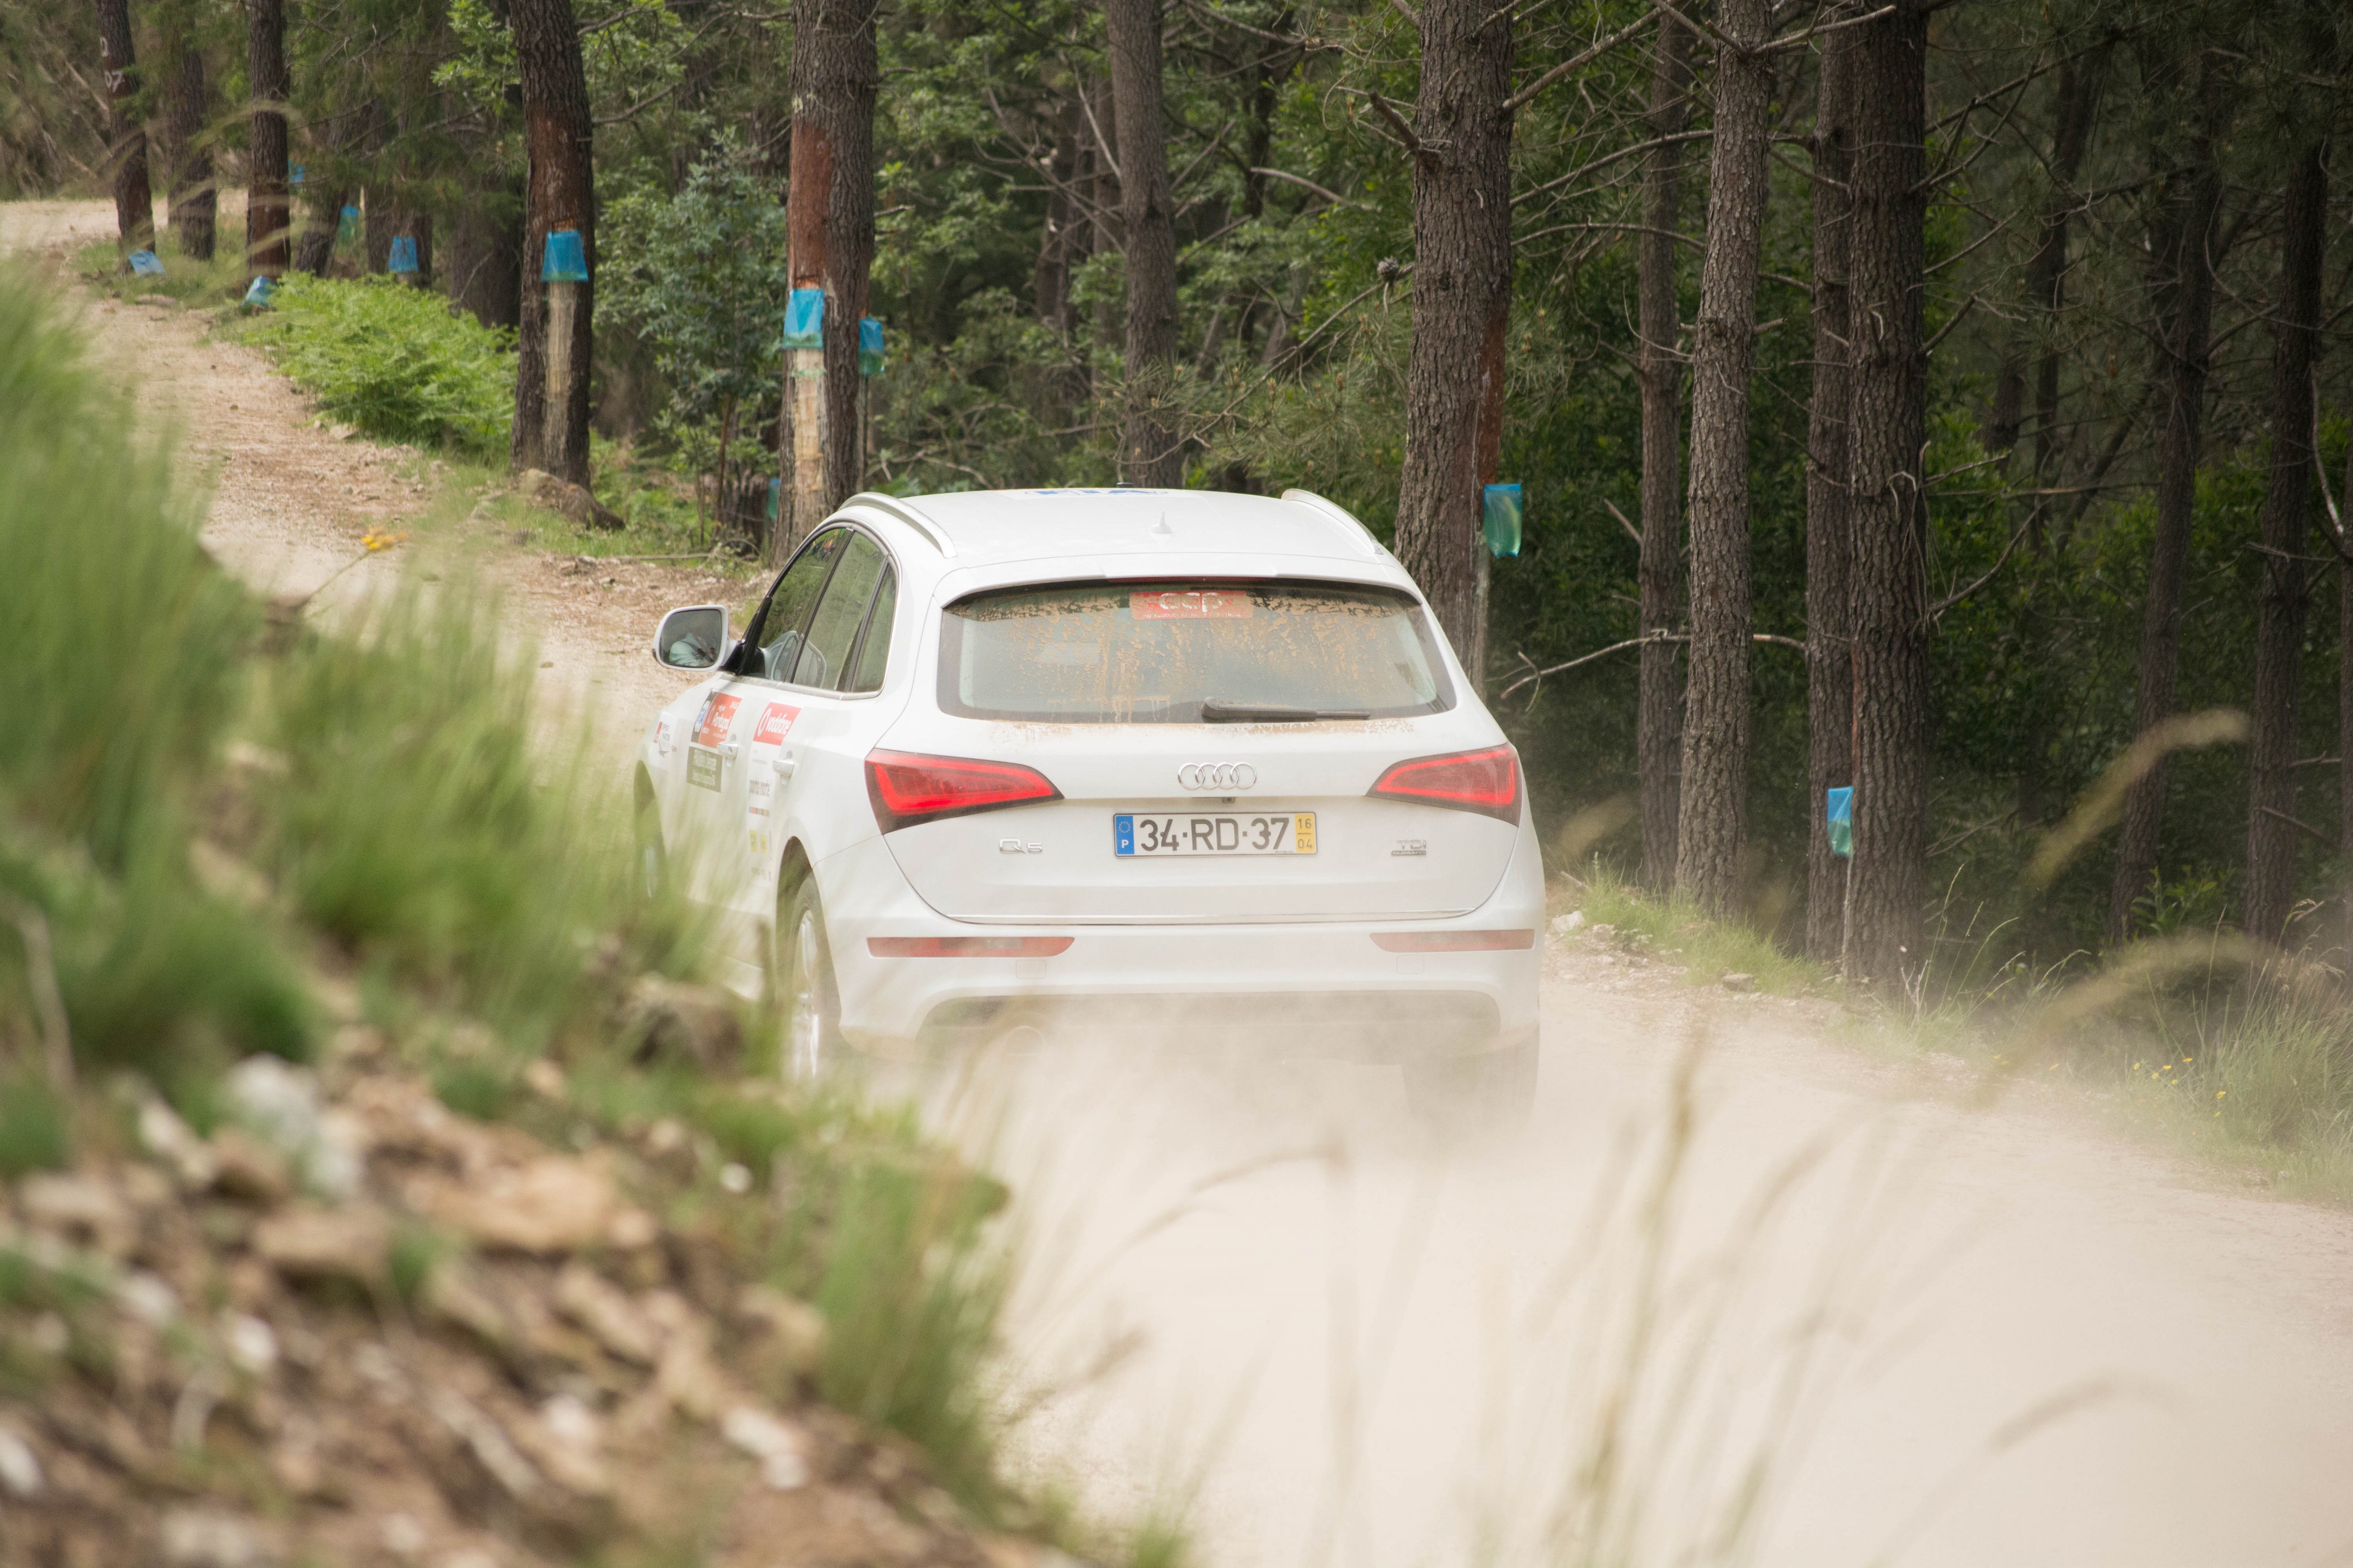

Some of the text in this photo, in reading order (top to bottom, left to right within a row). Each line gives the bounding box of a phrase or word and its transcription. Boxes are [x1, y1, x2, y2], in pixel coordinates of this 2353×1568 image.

[765, 713, 792, 735] vodafone
[1298, 819, 1312, 828] 16
[999, 838, 1042, 853] Q5
[1121, 839, 1129, 848] P
[1298, 839, 1312, 849] 04
[1397, 839, 1426, 849] TDI
